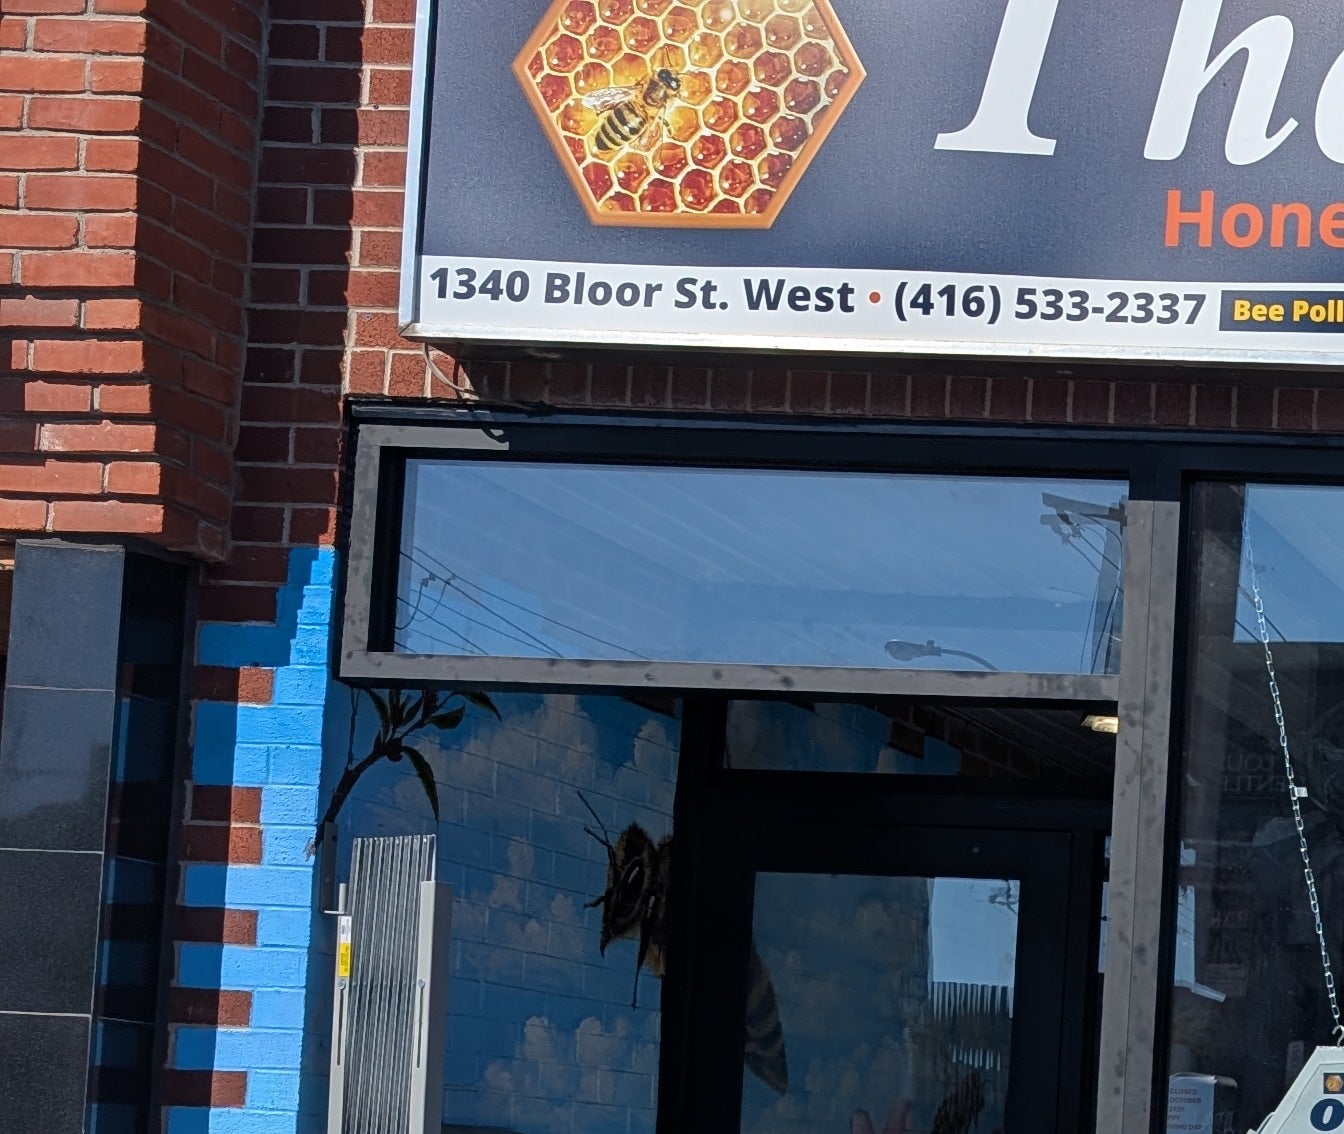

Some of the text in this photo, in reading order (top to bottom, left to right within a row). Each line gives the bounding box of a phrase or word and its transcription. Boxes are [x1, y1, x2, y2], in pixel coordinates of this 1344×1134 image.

[430, 268, 1207, 325] 1340 Bloor St. West (416) 533-2337
[1234, 300, 1284, 320] Bee
